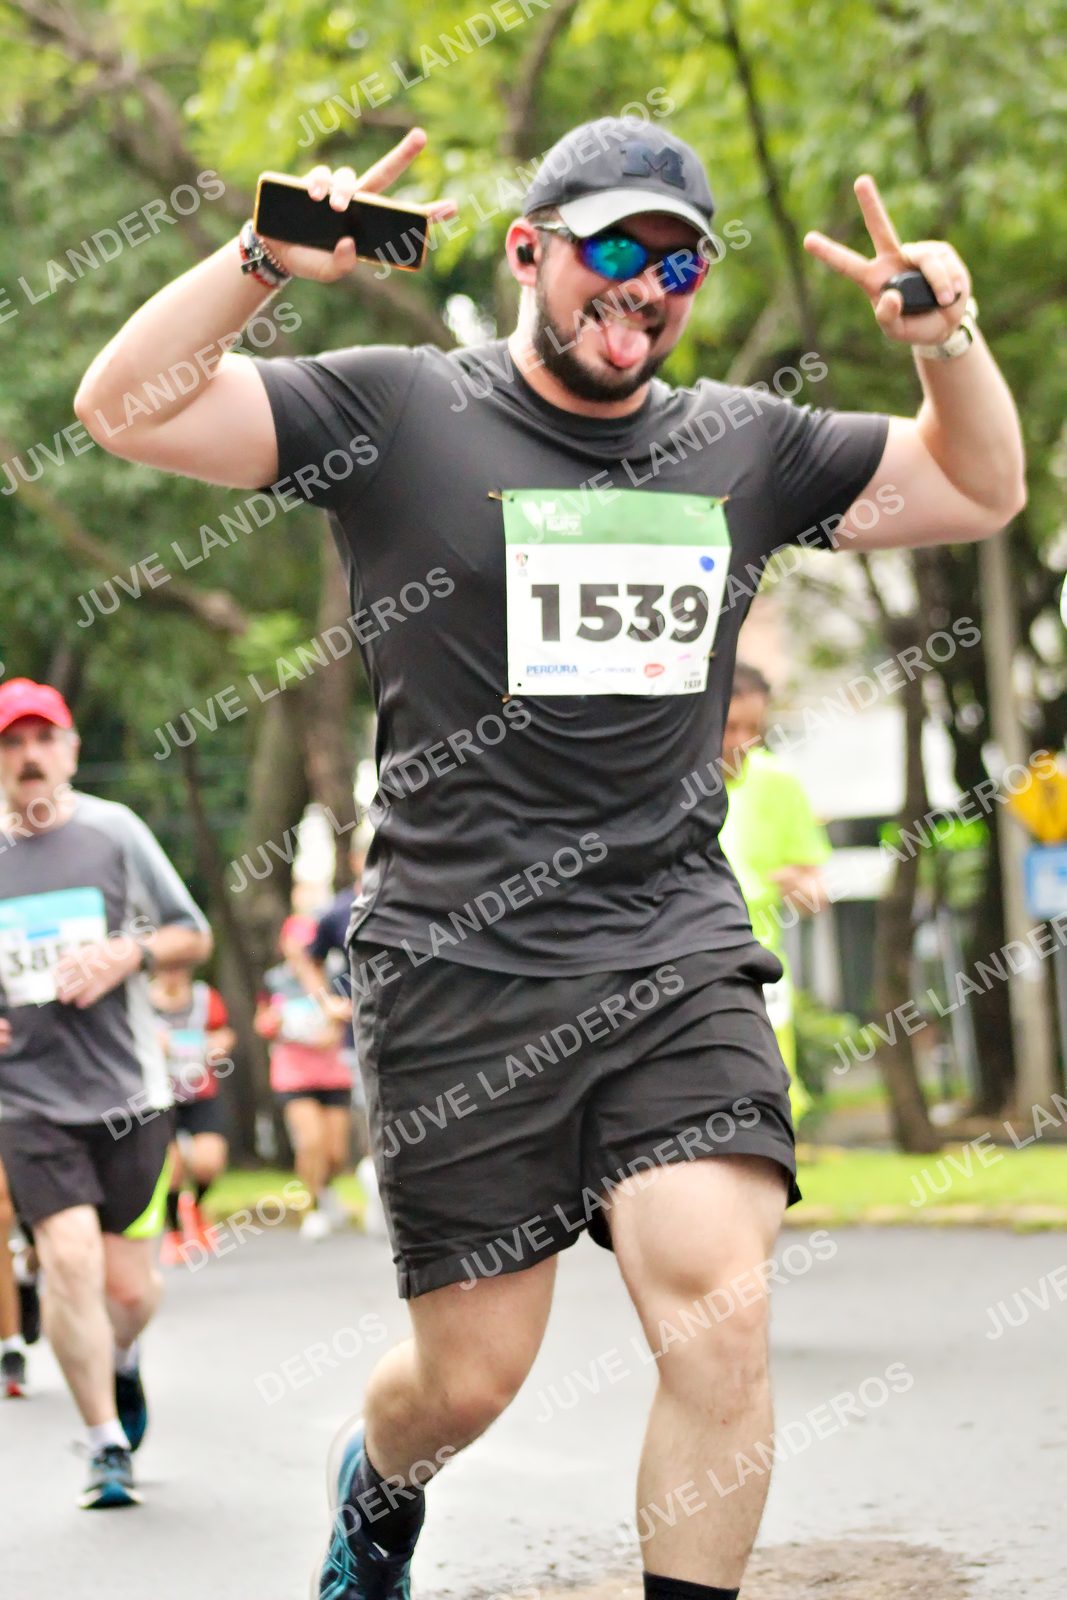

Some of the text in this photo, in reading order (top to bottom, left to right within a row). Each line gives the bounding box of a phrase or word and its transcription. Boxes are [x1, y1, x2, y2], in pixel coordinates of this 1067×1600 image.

[620, 143, 687, 191] M
[531, 583, 709, 643] 1539
[526, 665, 578, 675] PERDURA
